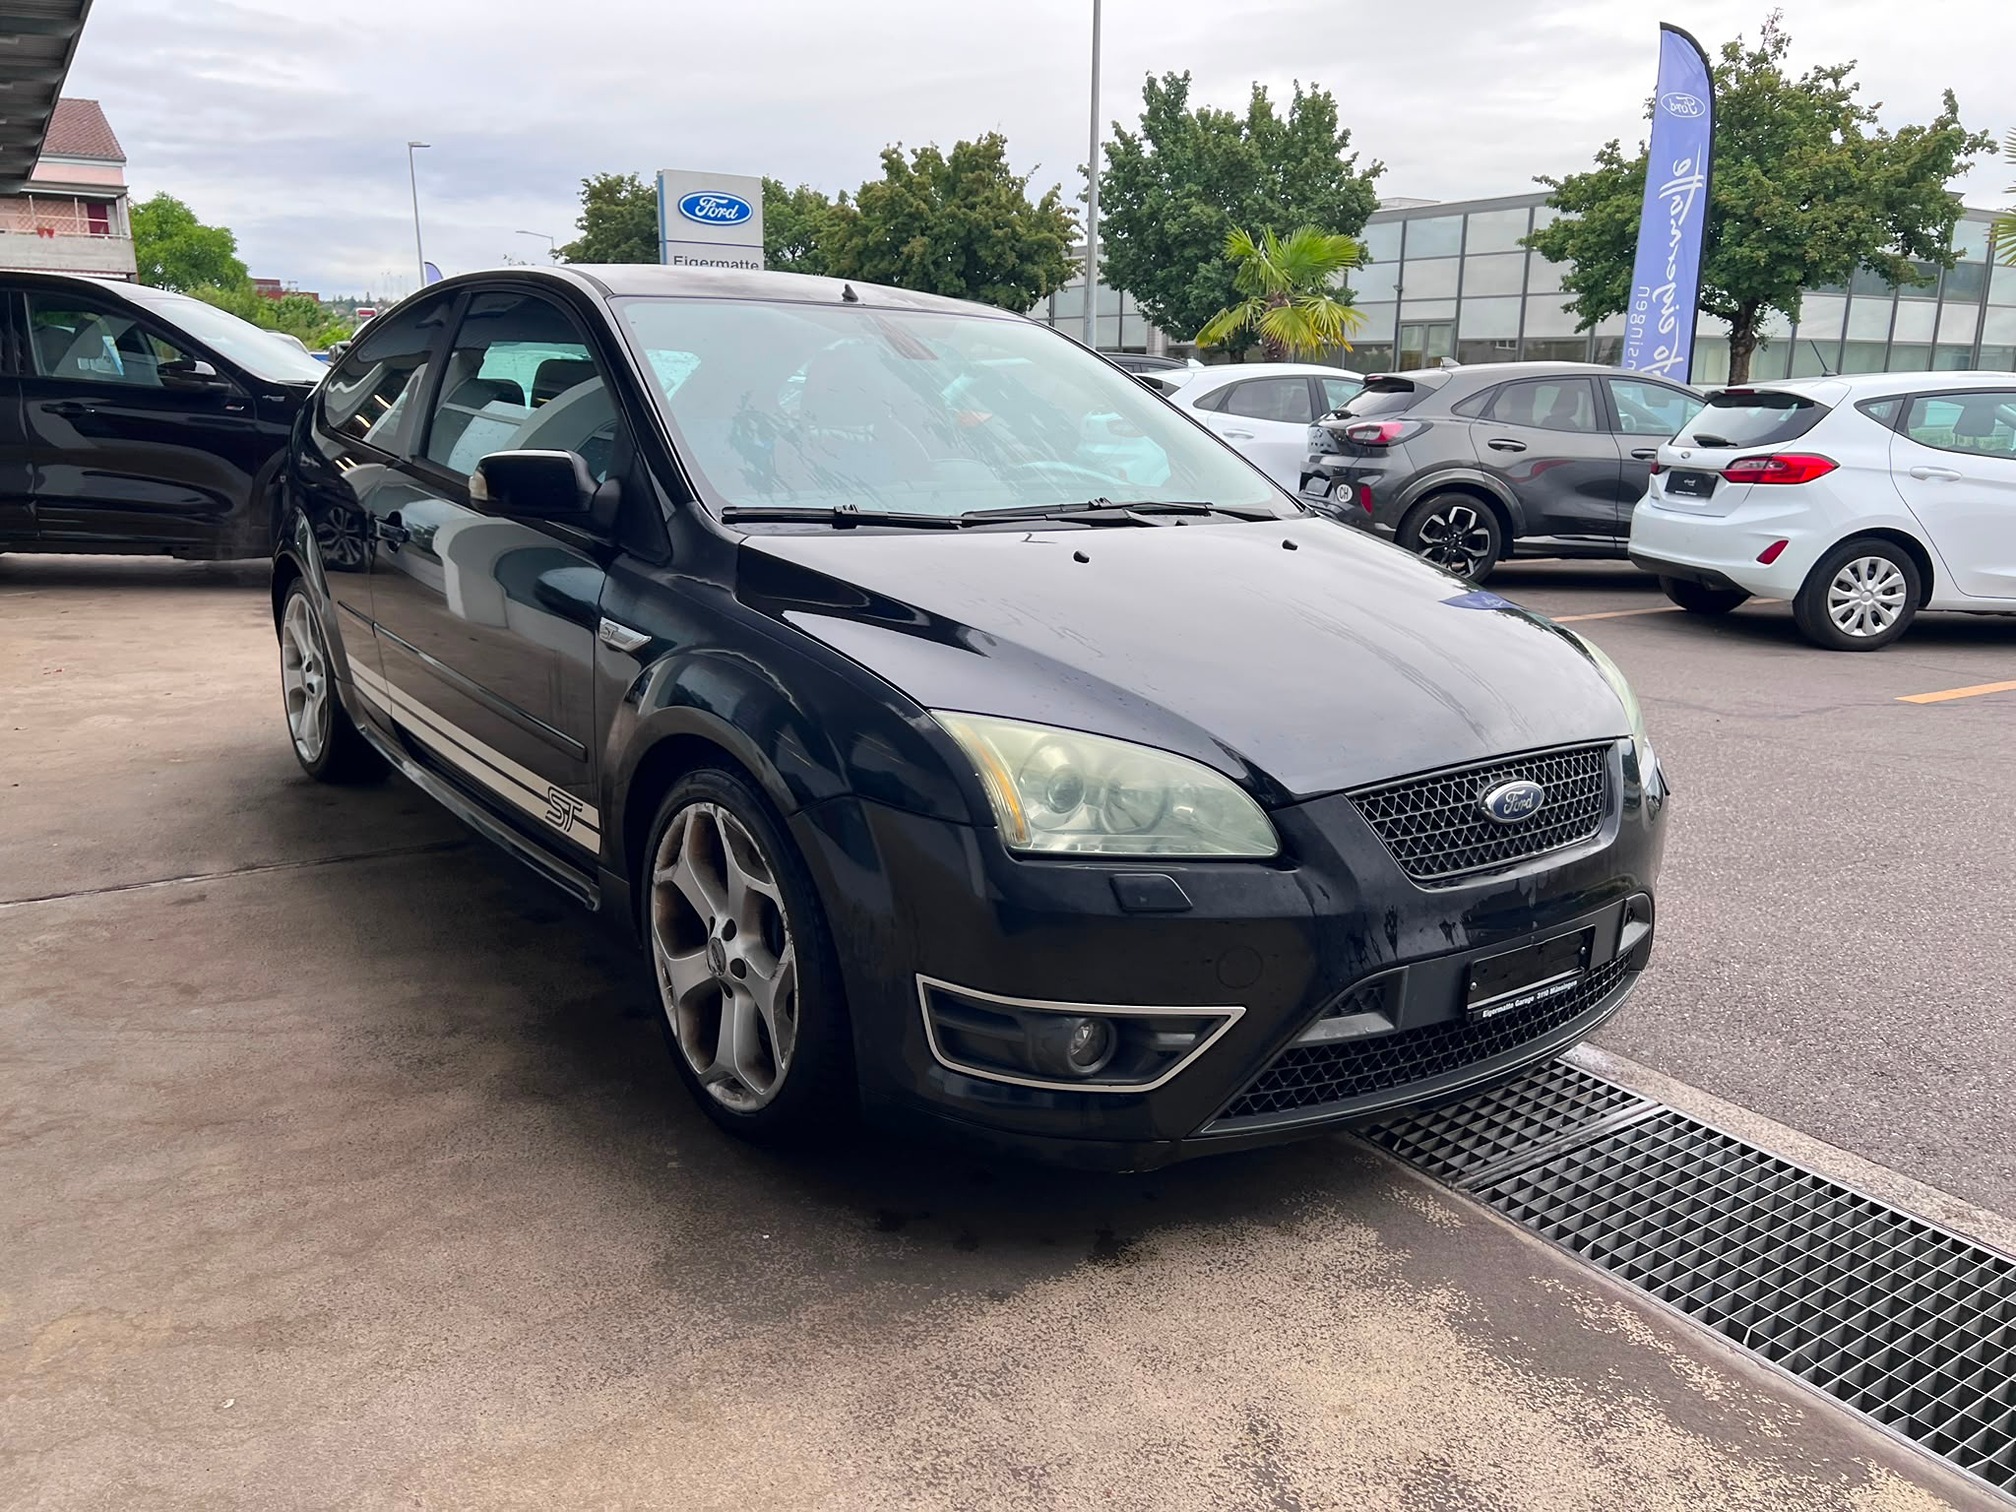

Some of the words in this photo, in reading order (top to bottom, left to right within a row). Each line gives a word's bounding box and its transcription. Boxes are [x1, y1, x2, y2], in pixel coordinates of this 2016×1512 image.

[694, 196, 740, 219] Ford
[545, 785, 583, 832] ST
[1503, 790, 1534, 814] Ford
